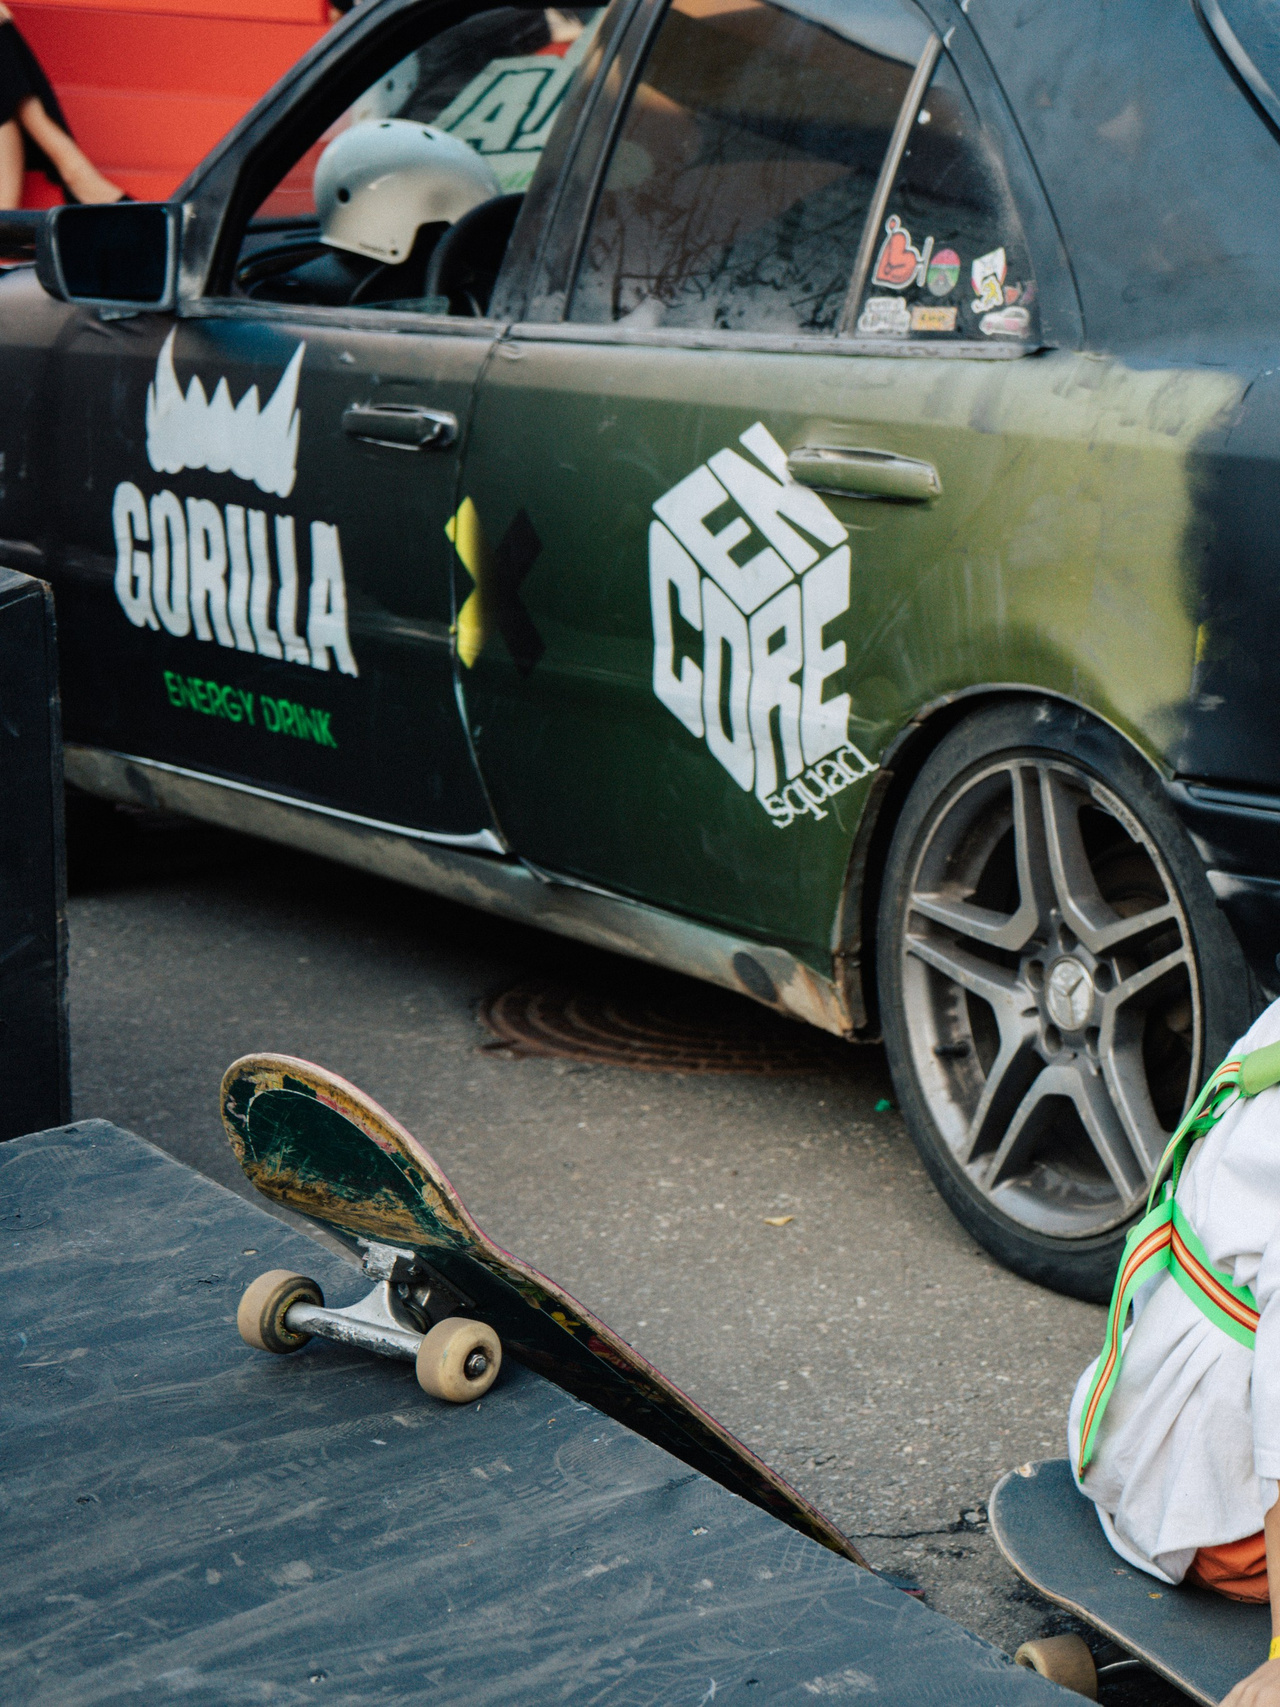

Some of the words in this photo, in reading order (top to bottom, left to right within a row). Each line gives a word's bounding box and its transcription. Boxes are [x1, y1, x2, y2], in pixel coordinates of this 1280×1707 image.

[112, 480, 359, 679] GORILLA
[163, 669, 255, 726] ENERGY
[260, 695, 338, 749] DRINK
[764, 740, 881, 829] squad
